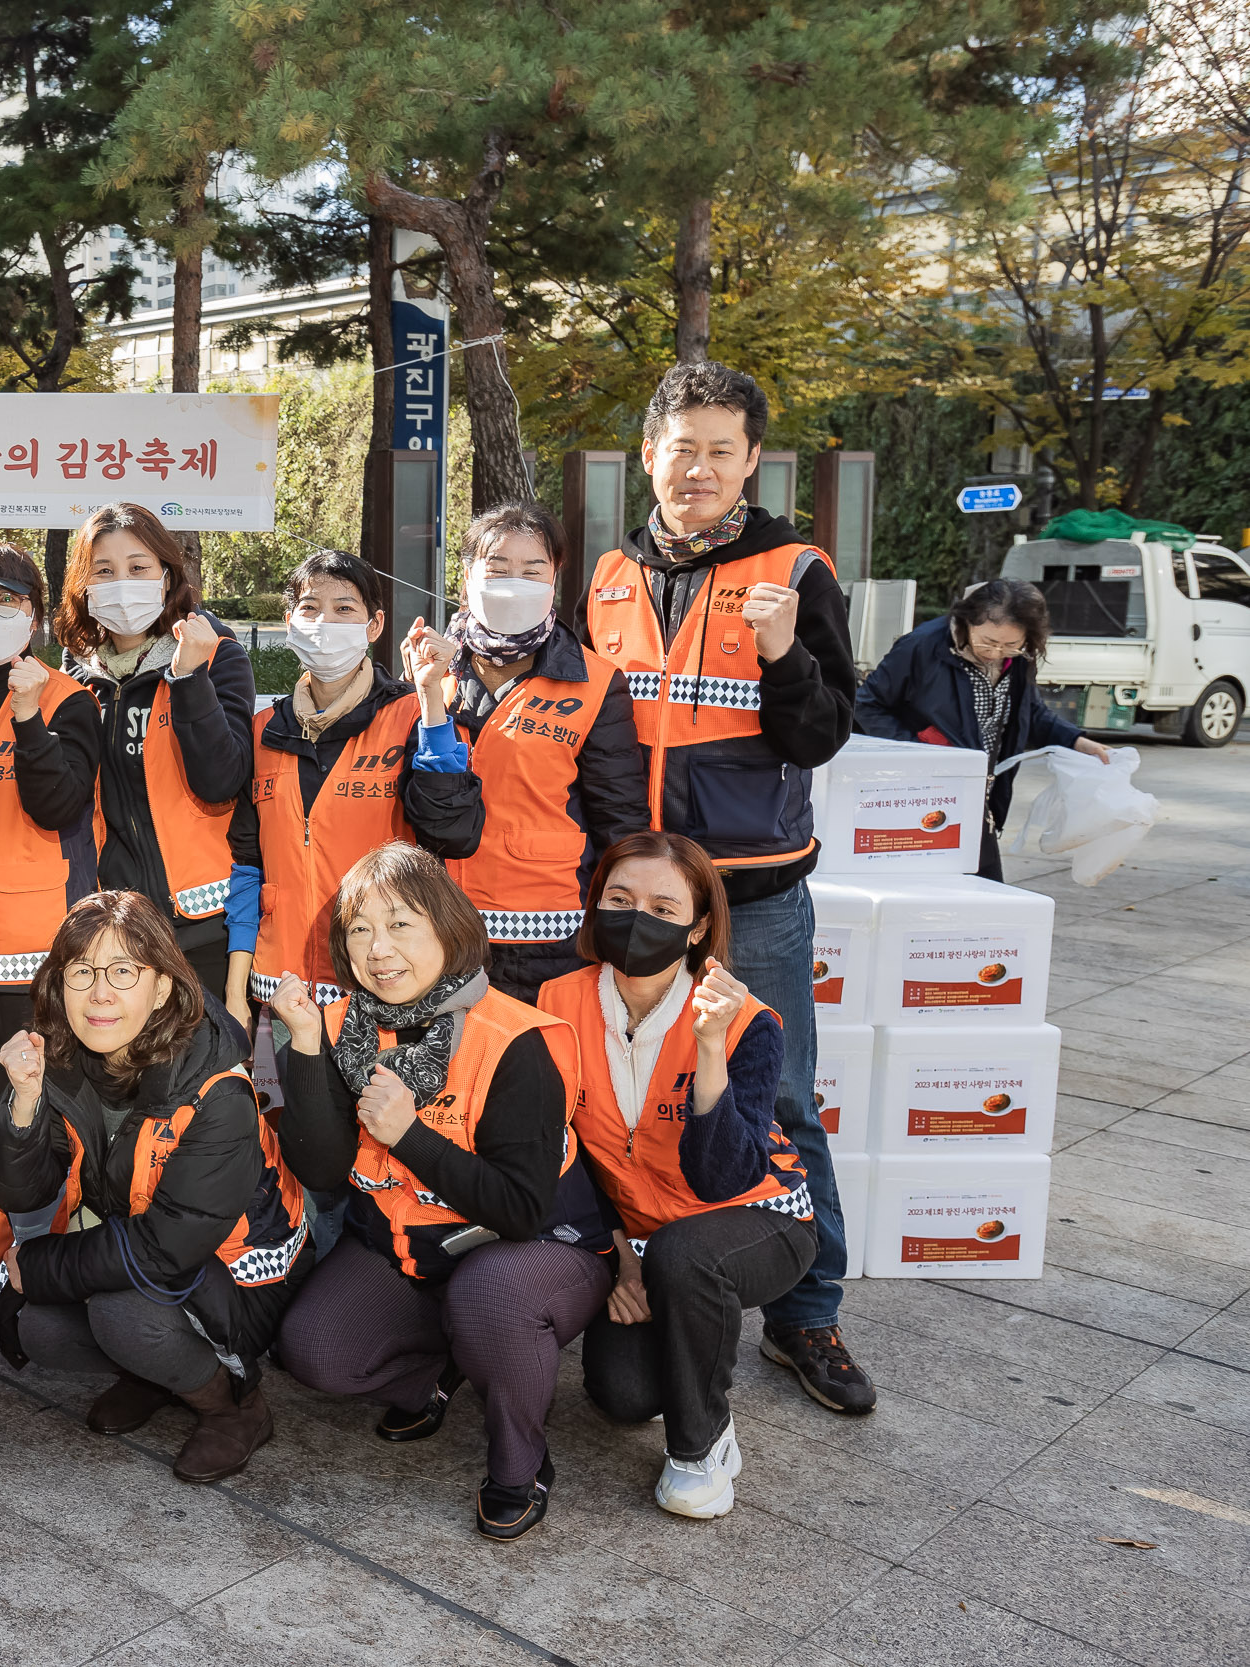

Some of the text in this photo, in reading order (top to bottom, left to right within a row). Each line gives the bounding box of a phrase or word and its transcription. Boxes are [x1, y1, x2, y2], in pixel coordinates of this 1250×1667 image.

[55, 437, 219, 482] 김장축제
[0, 504, 47, 515] 광진복지재단
[185, 507, 244, 518] 한국사회보장정보원
[717, 586, 749, 600] 119
[524, 695, 584, 719] 119
[506, 715, 581, 748] 의용소방대
[350, 744, 406, 773] 119
[859, 796, 957, 809] 2023 제1회 광진 사랑의 김장축제
[909, 948, 1018, 960] 2023 제1회 광진 사랑의 김장축제
[914, 1079, 1023, 1089] 2023 제1회 광진 사랑의 김장축제
[907, 1205, 1016, 1217] 2023 제1회 광진 사랑의 김장축제
